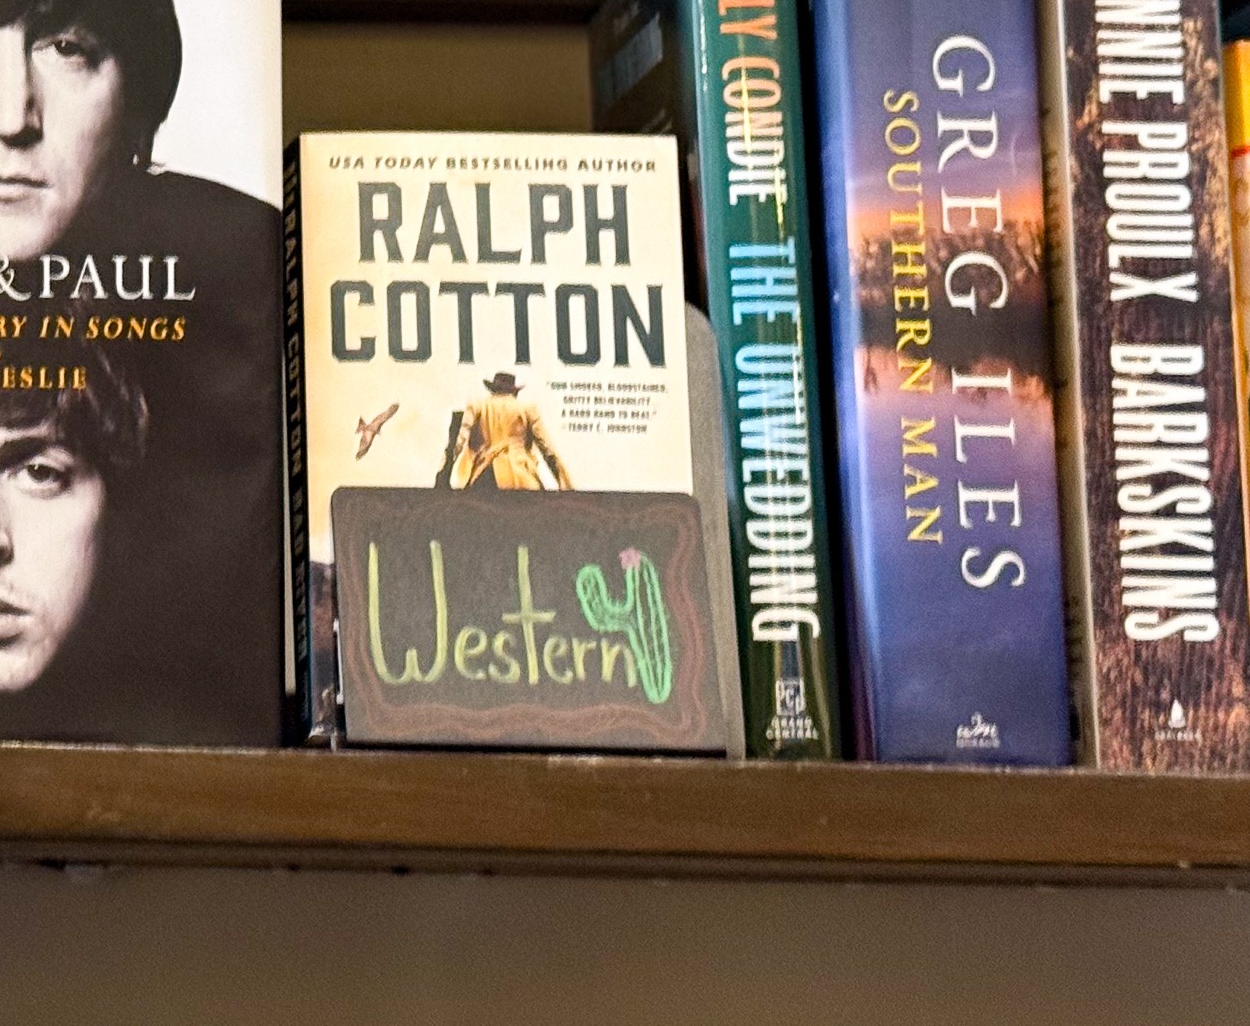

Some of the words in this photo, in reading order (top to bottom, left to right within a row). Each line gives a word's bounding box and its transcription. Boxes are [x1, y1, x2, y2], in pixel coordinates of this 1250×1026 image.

[328, 156, 366, 170] USA
[374, 156, 438, 171] TODAY
[445, 157, 569, 173] BESTSELLING
[577, 159, 657, 173] AUTHOR
[720, 55, 789, 207] CONDIE
[932, 34, 1010, 317] GREG
[283, 209, 299, 327] RALPH
[357, 181, 632, 266] RALPH
[728, 235, 798, 326] THE
[883, 88, 934, 395] SOUTHERN
[1099, 119, 1200, 305] PROULX
[39, 317, 76, 340] IN
[85, 317, 187, 342] SONGS
[329, 279, 668, 369] COTTON
[286, 333, 303, 478] COTTON
[734, 342, 821, 643] UNWEDDING
[900, 415, 944, 546] MAN
[951, 367, 1027, 592] ILES
[1109, 342, 1221, 643] BARKSKINS
[367, 540, 639, 688] Western
